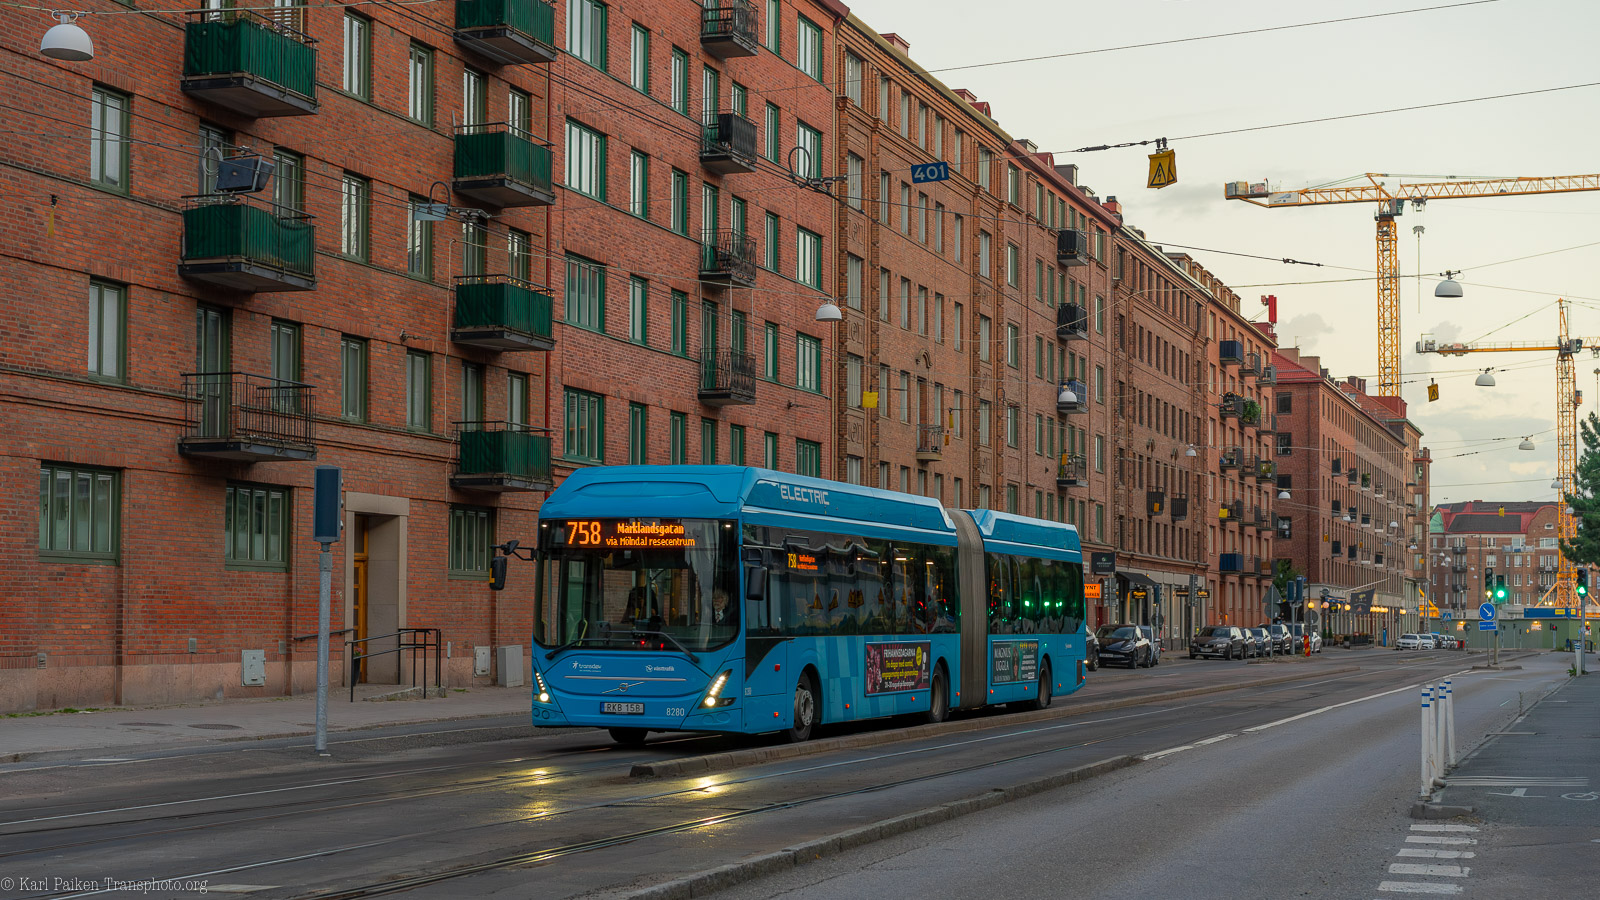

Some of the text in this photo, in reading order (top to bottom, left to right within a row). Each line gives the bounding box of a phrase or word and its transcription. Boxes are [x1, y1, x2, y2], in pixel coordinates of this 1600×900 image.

[914, 165, 945, 180] 401
[780, 485, 829, 505] ELECTRIC
[567, 521, 601, 545] 758
[606, 536, 696, 546] via Mölndal resecentrum
[787, 553, 797, 568] 758
[995, 660, 1010, 671] UGGLA
[607, 703, 623, 712] RKB
[666, 707, 685, 717] 8280
